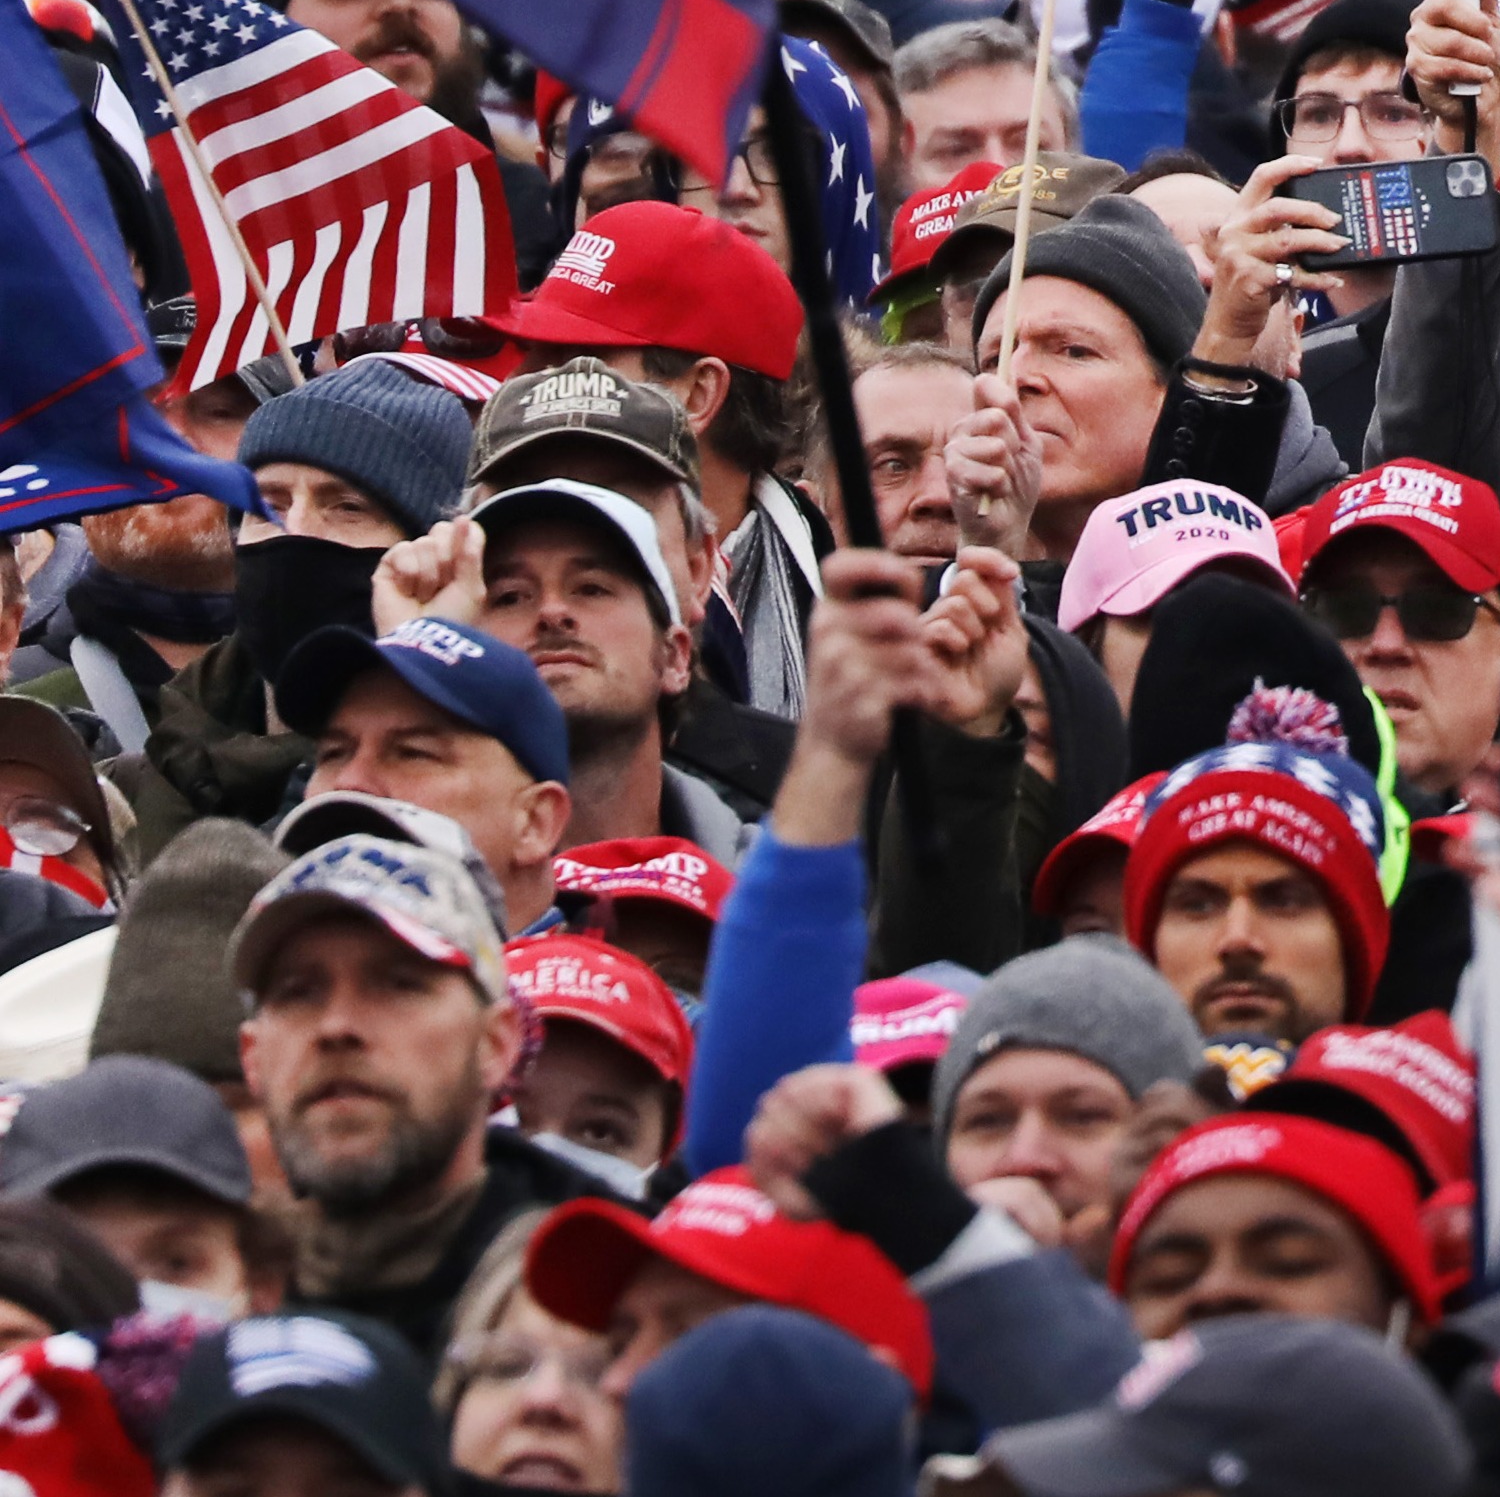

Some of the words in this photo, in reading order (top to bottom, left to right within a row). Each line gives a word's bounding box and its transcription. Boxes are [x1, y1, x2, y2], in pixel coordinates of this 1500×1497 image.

[909, 191, 950, 223] MAKE
[570, 273, 616, 295] GREAT
[531, 372, 616, 405] TRUMP
[1116, 491, 1263, 538] TRUMP
[1175, 526, 1230, 542] 2020
[506, 967, 631, 1003] MERICA
